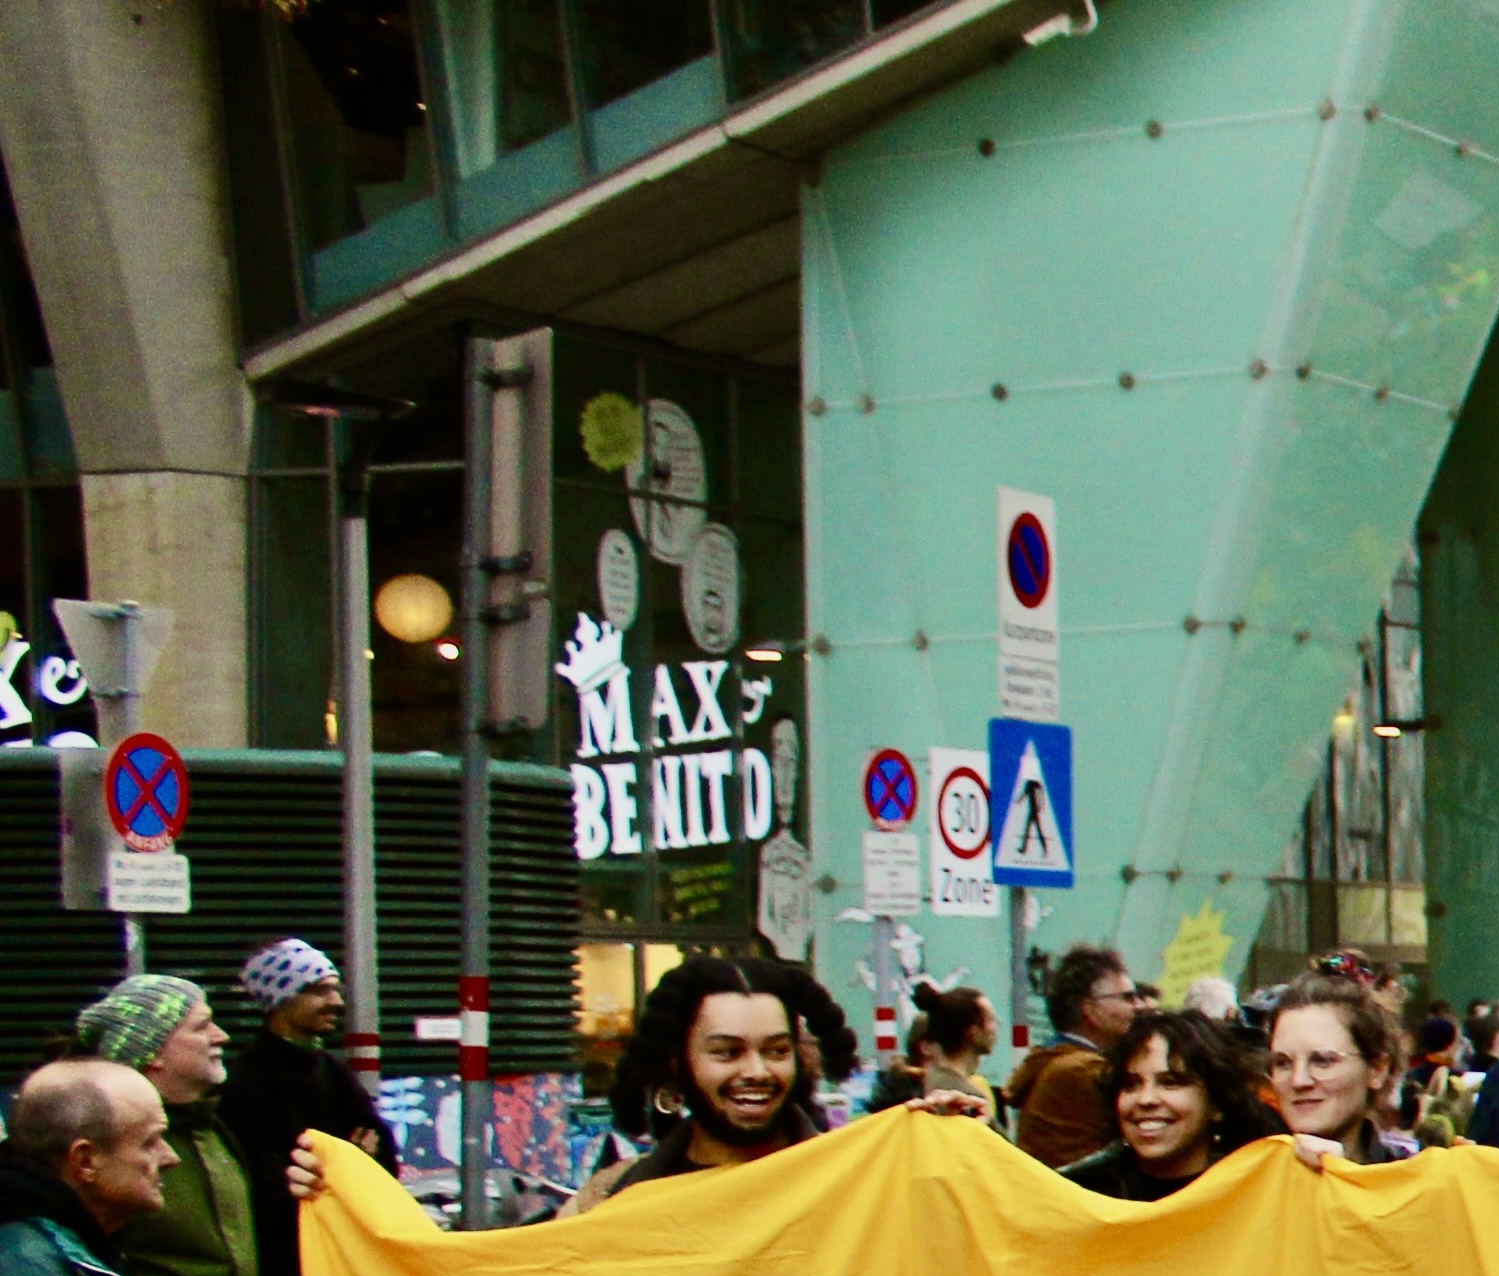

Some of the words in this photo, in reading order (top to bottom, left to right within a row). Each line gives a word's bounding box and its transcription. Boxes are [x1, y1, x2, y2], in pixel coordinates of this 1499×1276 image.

[576, 660, 732, 758] MAX
[570, 747, 774, 861] BENITO
[950, 791, 982, 835] 30
[941, 866, 992, 905] Zone
